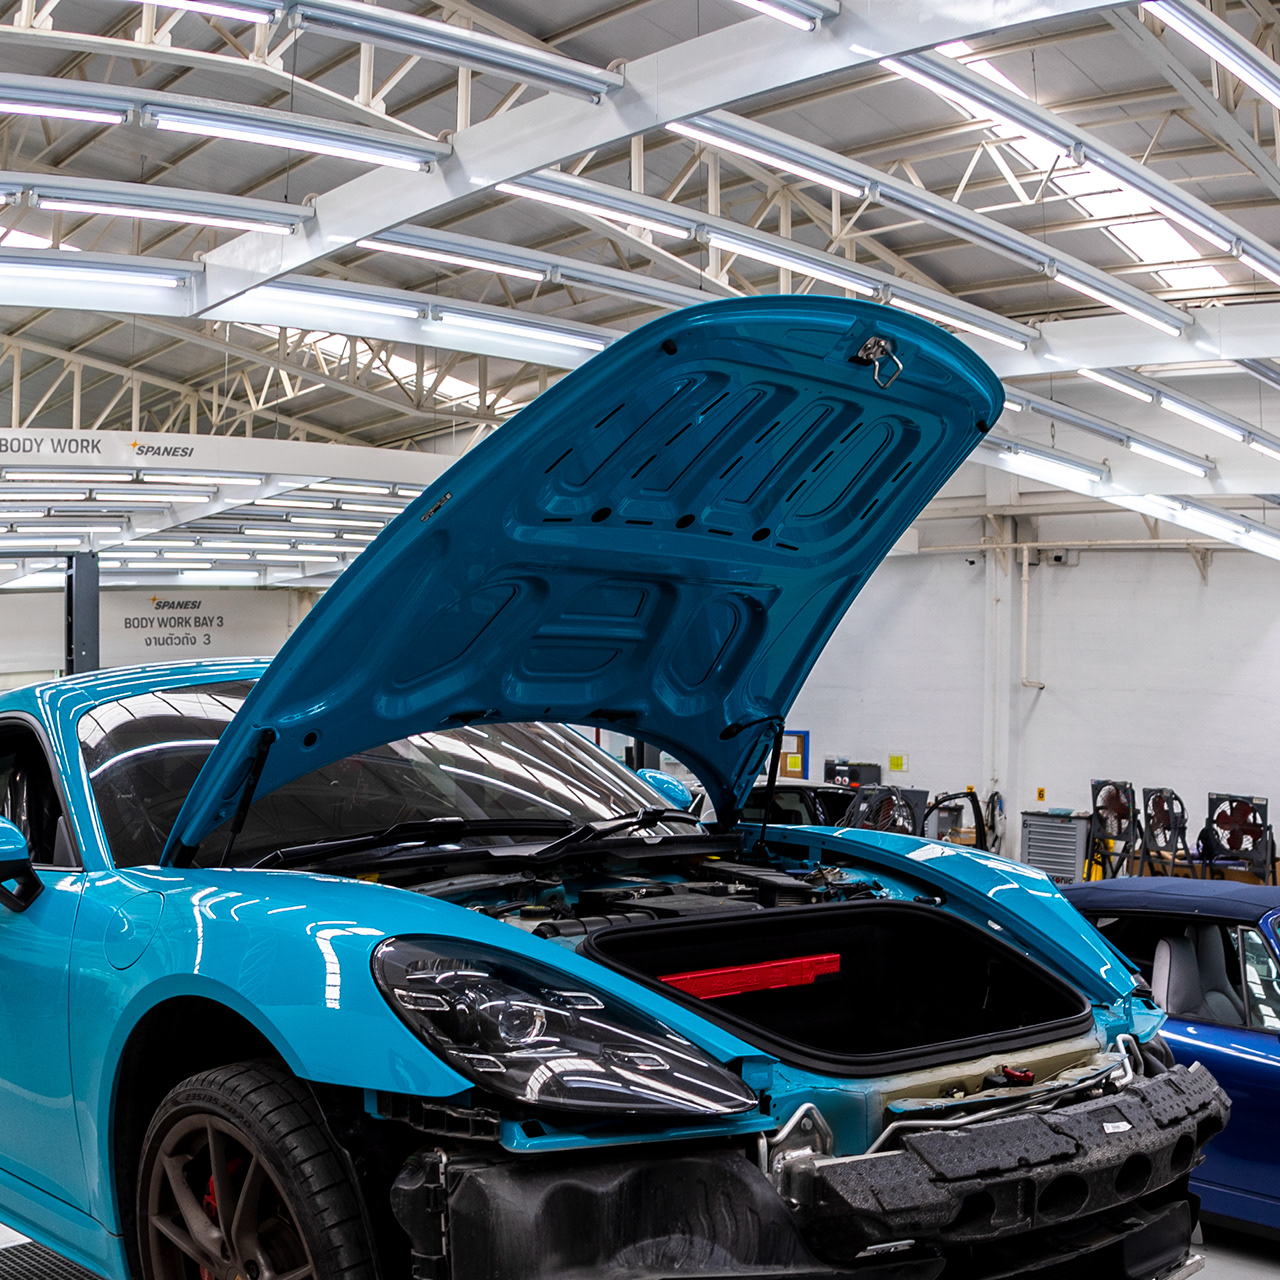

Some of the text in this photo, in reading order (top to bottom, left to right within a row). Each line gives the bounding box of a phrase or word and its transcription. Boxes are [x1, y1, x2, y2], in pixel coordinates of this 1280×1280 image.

[50, 438, 102, 454] WORK
[135, 445, 195, 458] SPANESI
[154, 600, 202, 610] SPANESI
[124, 616, 224, 629] BODY WORK BAY 3
[144, 632, 212, 646] งานตัวถัง 3
[1038, 789, 1044, 799] 6
[1023, 820, 1028, 828] 6
